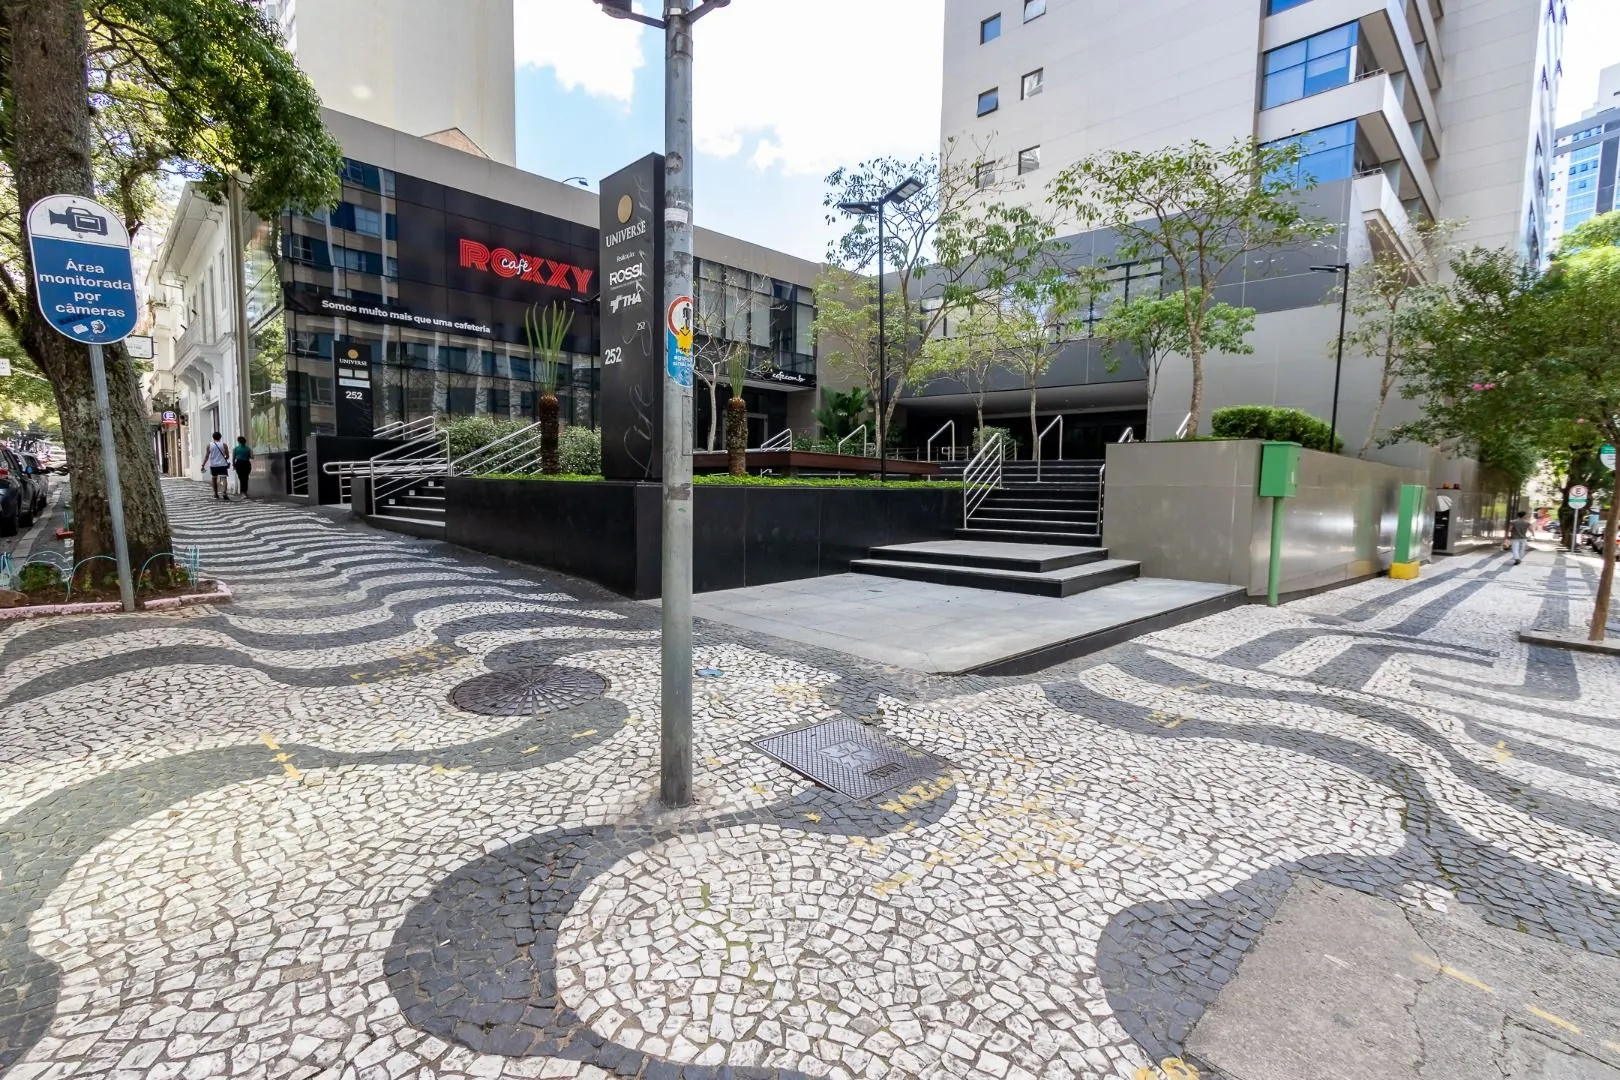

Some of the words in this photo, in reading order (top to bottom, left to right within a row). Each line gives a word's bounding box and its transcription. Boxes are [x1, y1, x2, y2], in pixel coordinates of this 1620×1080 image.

[606, 220, 646, 248] UNIVERSE
[66, 258, 104, 274] Área
[459, 238, 593, 293] ROXXY
[501, 258, 533, 275] café
[609, 262, 643, 286] ROSSI
[40, 273, 132, 290] monitorada
[74, 291, 101, 302] por
[55, 303, 126, 317] câmeras
[321, 300, 357, 312] Somos
[359, 307, 388, 317] muito
[390, 312, 413, 321] mais
[414, 316, 431, 325] que
[433, 319, 453, 327] uma
[454, 322, 491, 334] cafeteria
[339, 358, 368, 366] UNIVERSE
[604, 346, 622, 365] 252
[345, 390, 363, 400] 252
